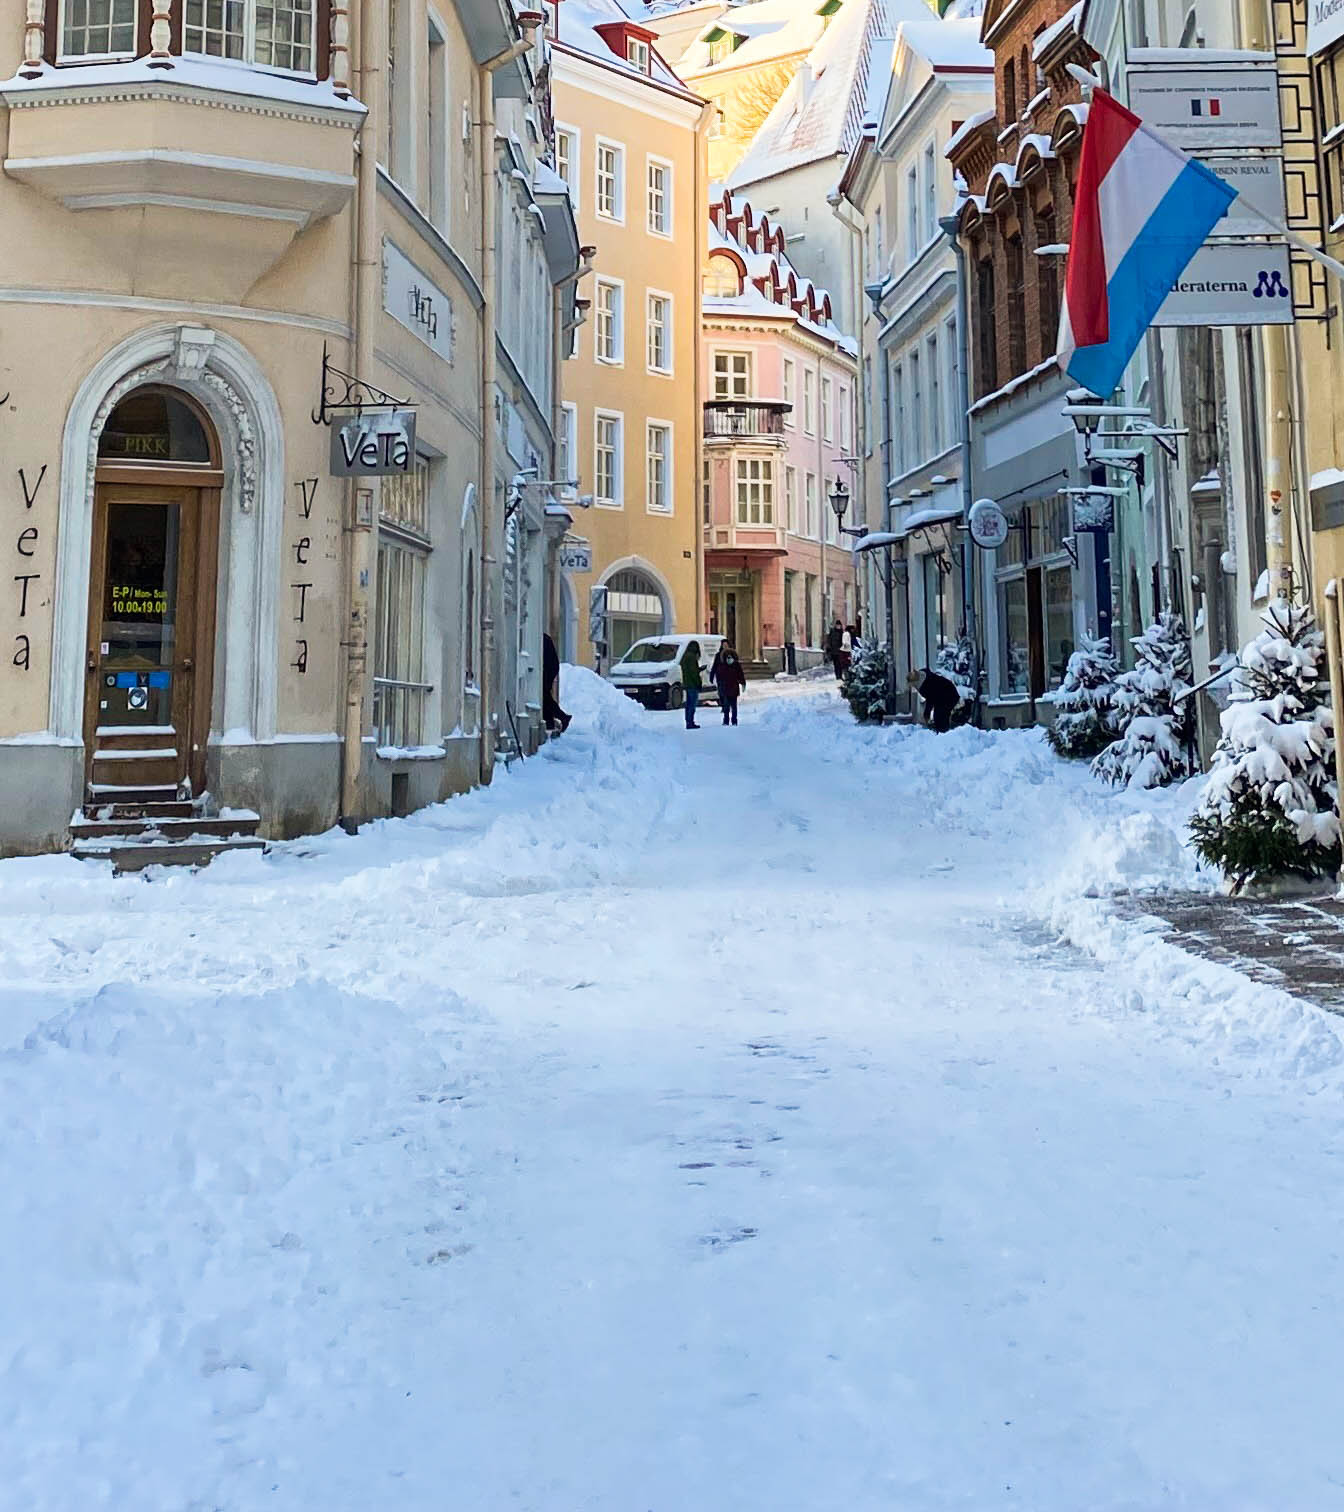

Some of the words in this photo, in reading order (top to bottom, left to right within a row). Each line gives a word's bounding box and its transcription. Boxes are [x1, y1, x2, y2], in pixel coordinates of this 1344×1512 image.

[1241, 166, 1271, 174] REVAL
[1170, 280, 1248, 292] deraterna
[340, 431, 409, 470] VeTa
